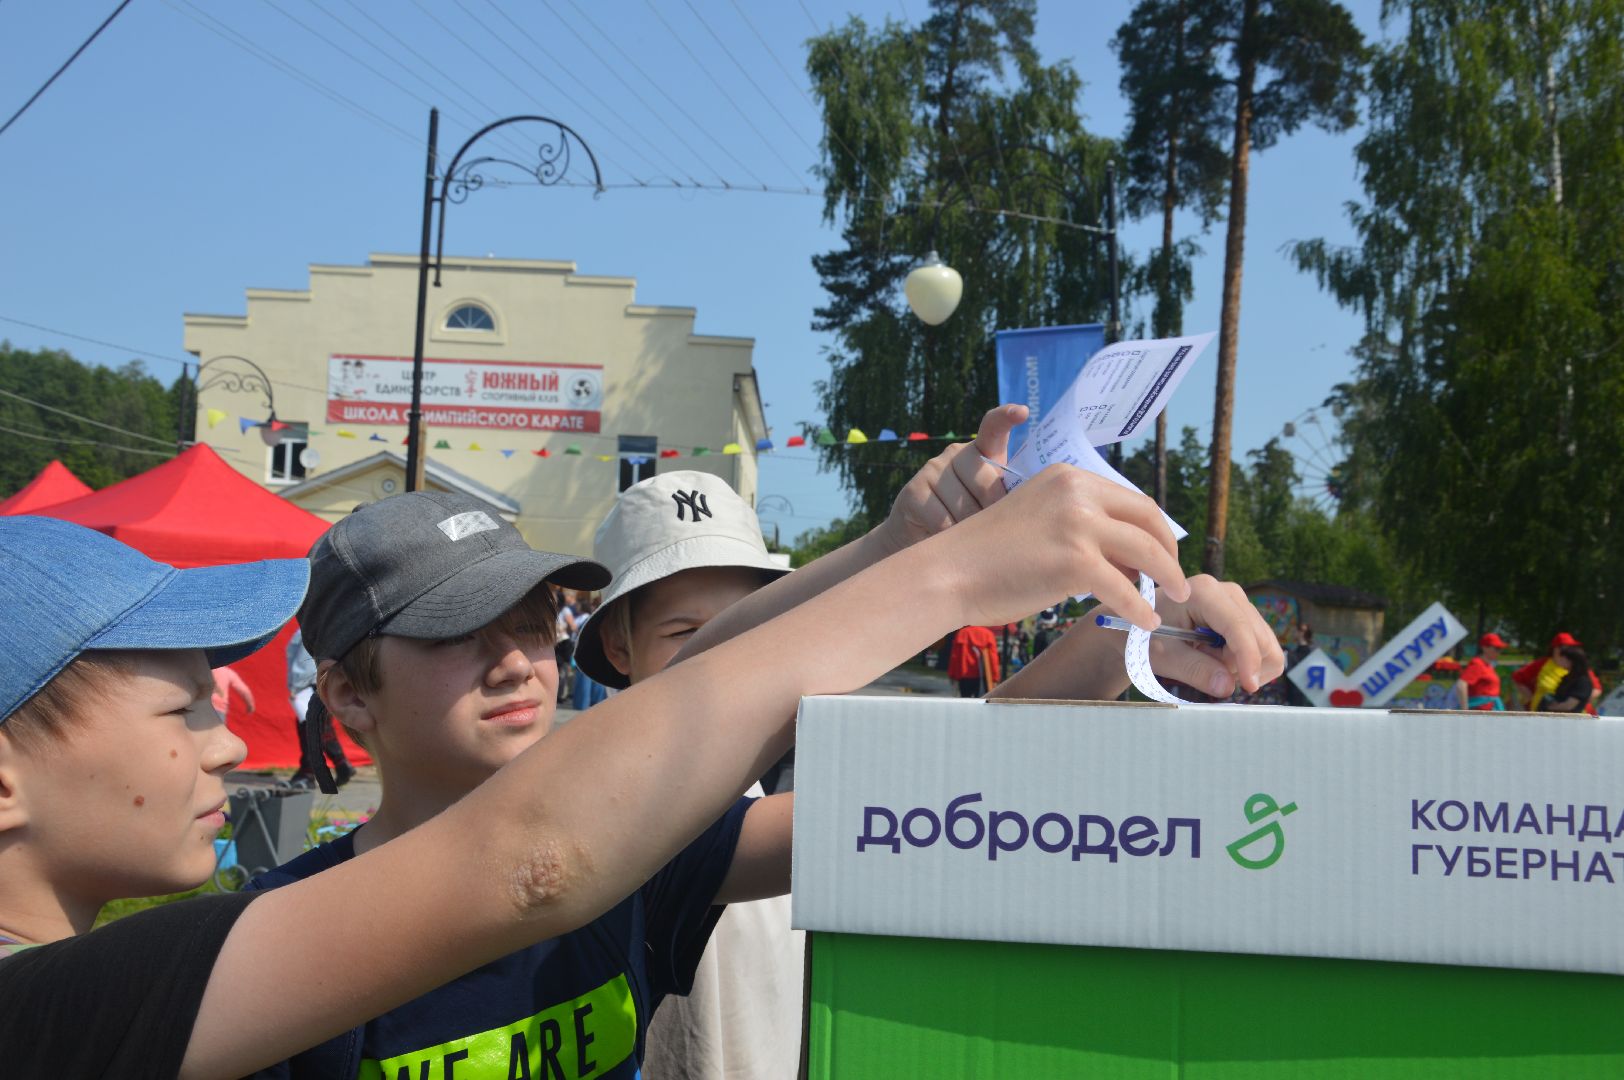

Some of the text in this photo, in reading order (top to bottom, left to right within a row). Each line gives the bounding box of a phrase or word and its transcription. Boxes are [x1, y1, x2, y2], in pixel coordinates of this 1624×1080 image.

[376, 383, 461, 398] ЕДИНООРСТВ
[402, 370, 437, 381] ЦТР
[482, 370, 559, 393] ЮЖНЫЙ
[1025, 355, 1040, 427] НИКОМ!
[343, 408, 399, 423] ШКОЛА
[531, 414, 585, 430] КАРАТЕ
[1306, 616, 1449, 698] Я ШАТУРУ
[857, 793, 1201, 863] добродел
[507, 1002, 598, 1080] ARE
